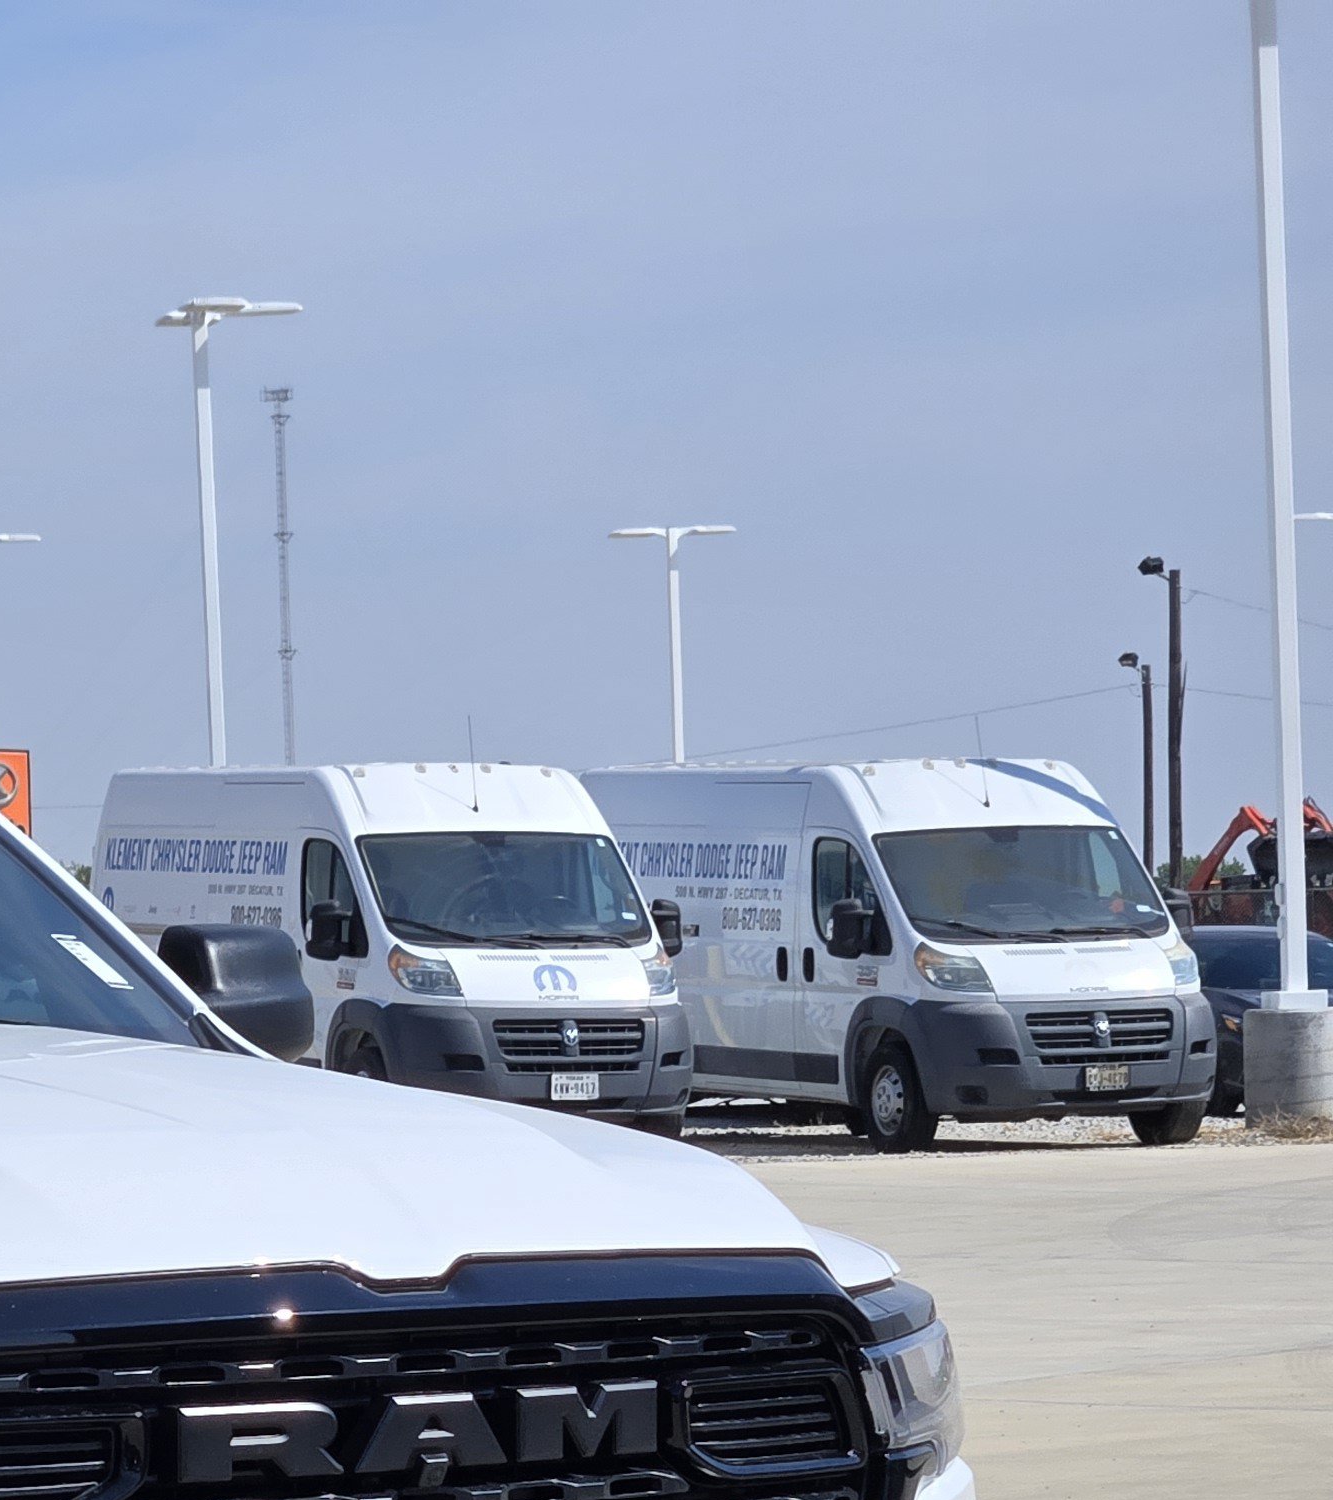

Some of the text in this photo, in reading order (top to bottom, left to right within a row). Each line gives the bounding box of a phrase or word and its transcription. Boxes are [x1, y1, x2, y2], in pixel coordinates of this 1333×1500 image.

[104, 838, 289, 876] KLEMENT CHRYSLER DODGE JEEP RAM
[640, 842, 694, 878] CHRYSLER
[694, 843, 731, 879] DODGE
[731, 843, 759, 880] JEEP
[759, 844, 788, 881] RAM
[697, 886, 714, 899] HWY
[715, 887, 729, 900] 287
[733, 887, 771, 902] DECATUR,
[772, 888, 783, 901] TX
[721, 906, 782, 932] 800-627-0386
[177, 1378, 658, 1484] RAM
